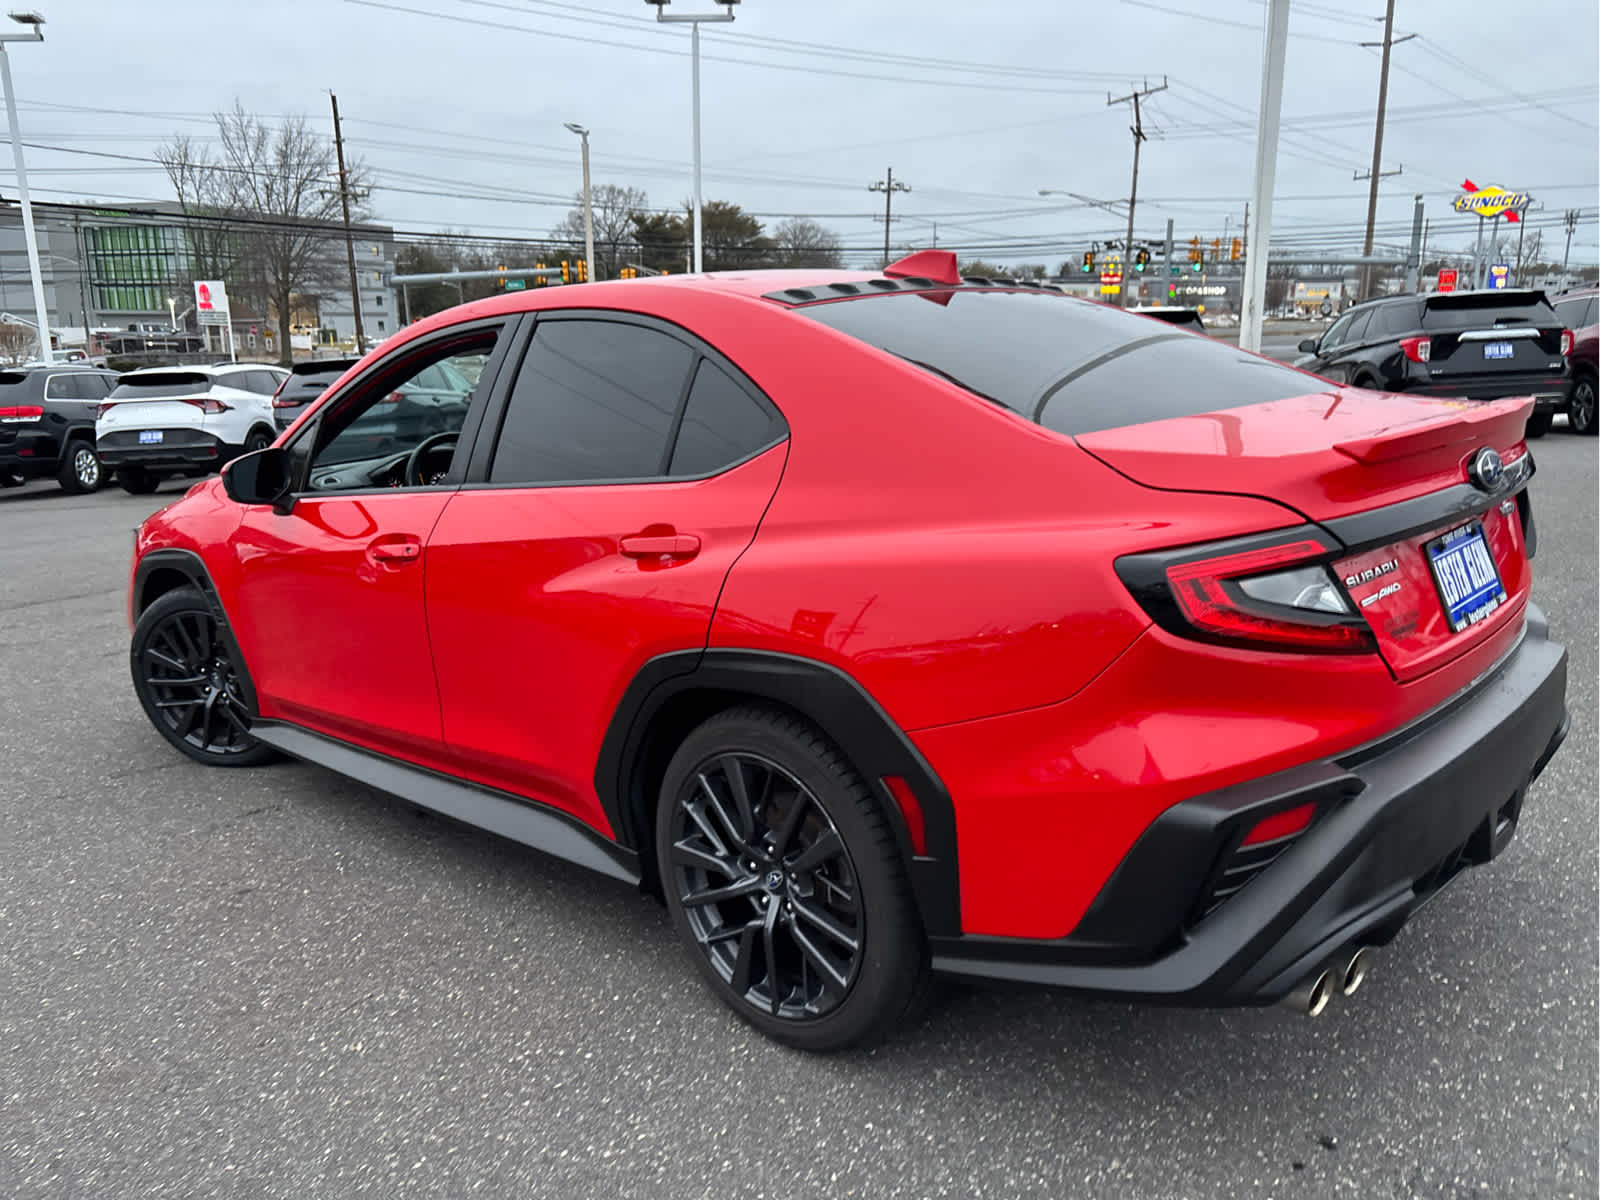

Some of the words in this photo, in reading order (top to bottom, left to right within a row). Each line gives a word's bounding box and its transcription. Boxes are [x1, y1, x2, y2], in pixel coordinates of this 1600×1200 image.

[1459, 193, 1523, 209] SUNOCO
[1345, 559, 1399, 588] SUBARU
[1434, 550, 1473, 607] LESTER
[1462, 538, 1497, 590] GLENN
[1378, 582, 1402, 601] AWD
